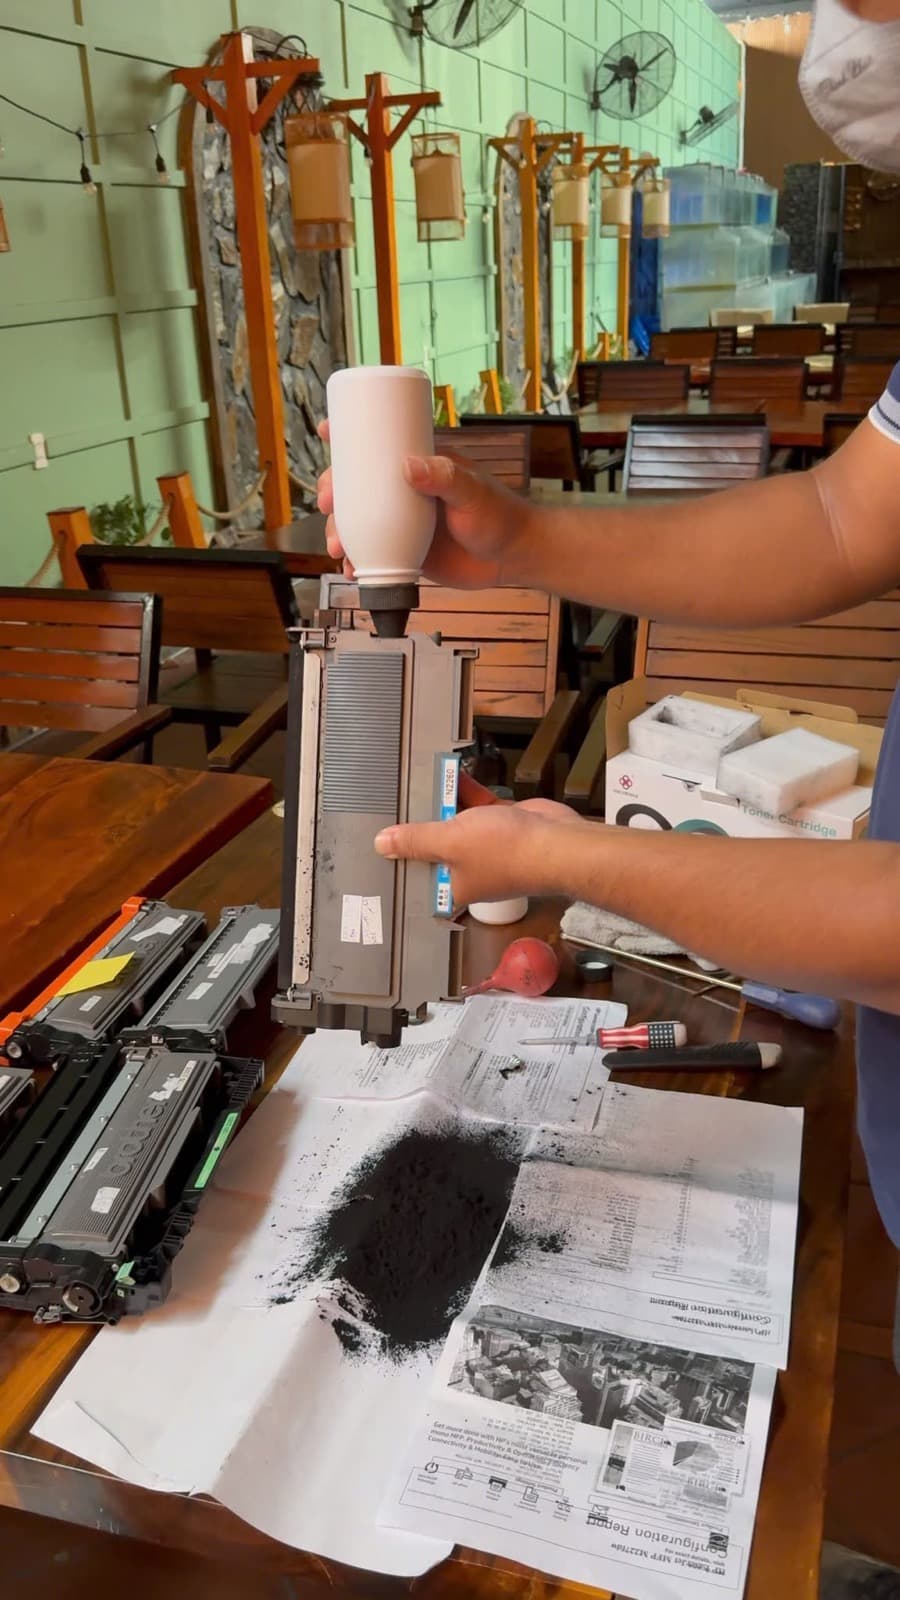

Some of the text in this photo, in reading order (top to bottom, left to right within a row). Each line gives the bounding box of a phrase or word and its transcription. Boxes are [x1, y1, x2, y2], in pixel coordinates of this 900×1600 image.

[777, 813, 838, 837] Cartridge
[433, 1421, 445, 1429] Get
[446, 1425, 463, 1433] more
[480, 1433, 495, 1441] with
[428, 1435, 467, 1450] Connectivity
[586, 1517, 631, 1536] Report
[634, 1528, 729, 1559] Configuration
[650, 1553, 672, 1564] MFP
